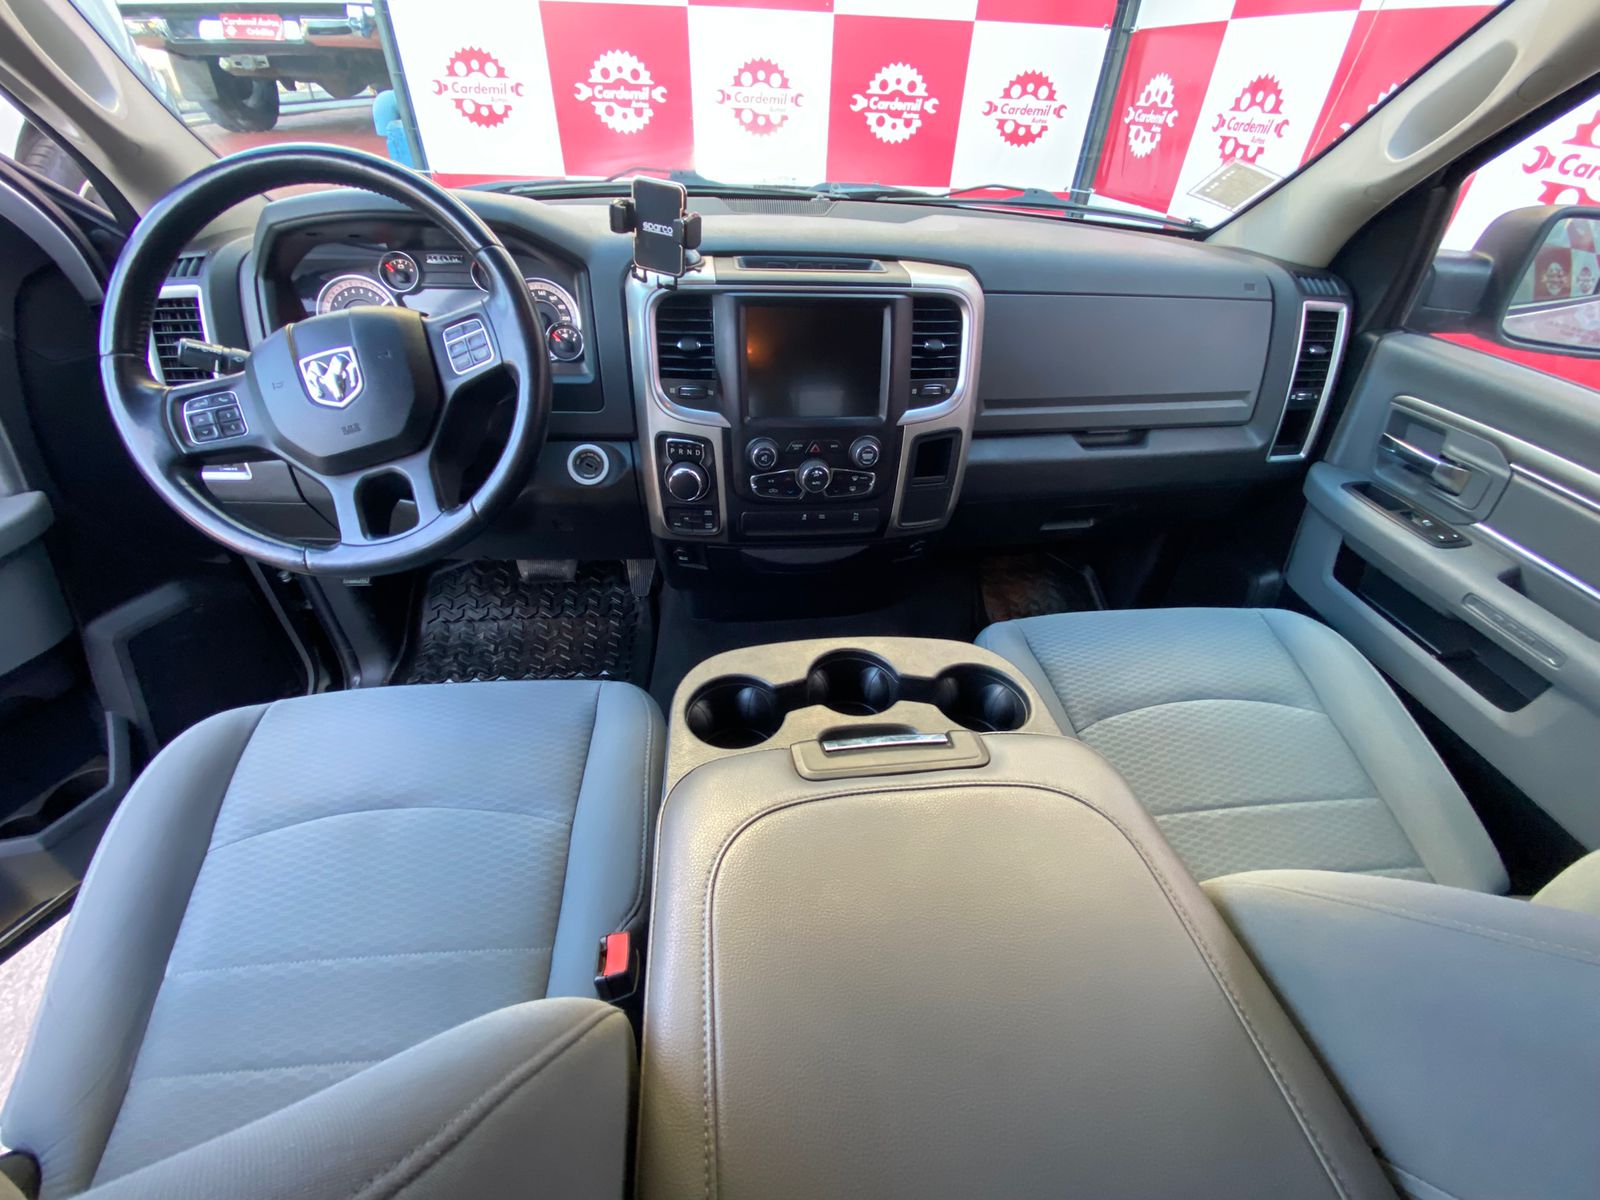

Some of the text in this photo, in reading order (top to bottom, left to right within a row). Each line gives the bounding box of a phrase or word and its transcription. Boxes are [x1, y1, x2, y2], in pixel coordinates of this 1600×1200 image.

[451, 82, 507, 95] Cardemil
[593, 84, 650, 100] Cardemil
[734, 91, 788, 105] Cardemil
[874, 96, 923, 111] Cardemil
[1000, 103, 1052, 116] Cardemil
[1134, 109, 1168, 125] Cardemil
[1227, 116, 1275, 134] Cardemil
[670, 447, 676, 455] P
